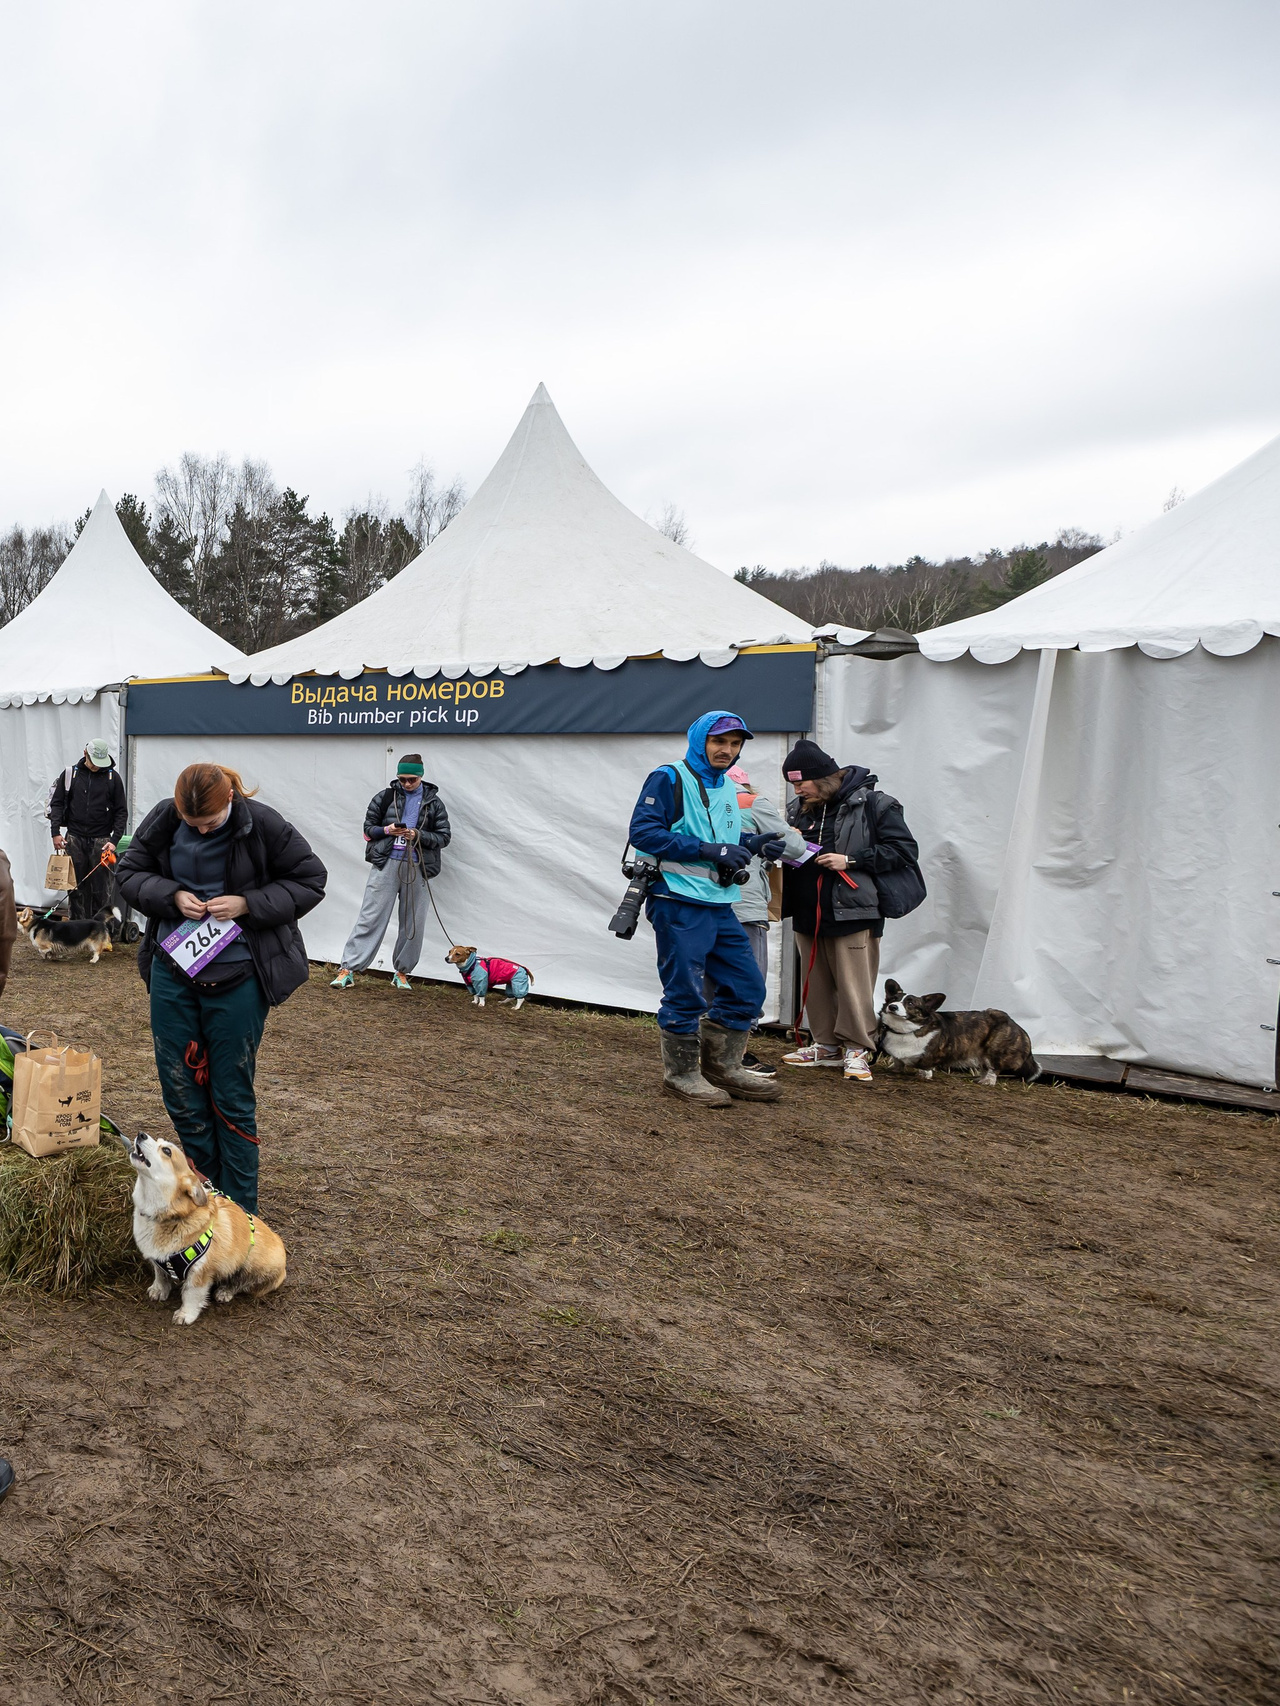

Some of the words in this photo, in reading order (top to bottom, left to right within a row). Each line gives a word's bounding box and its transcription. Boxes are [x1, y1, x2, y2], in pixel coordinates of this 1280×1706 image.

[291, 683, 378, 707] Выдача
[387, 680, 505, 705] номеров
[307, 709, 333, 725] Bib
[338, 708, 404, 725] number
[410, 706, 448, 727] pick
[455, 708, 479, 727] up
[726, 820, 734, 829] 37
[185, 922, 221, 958] 264
